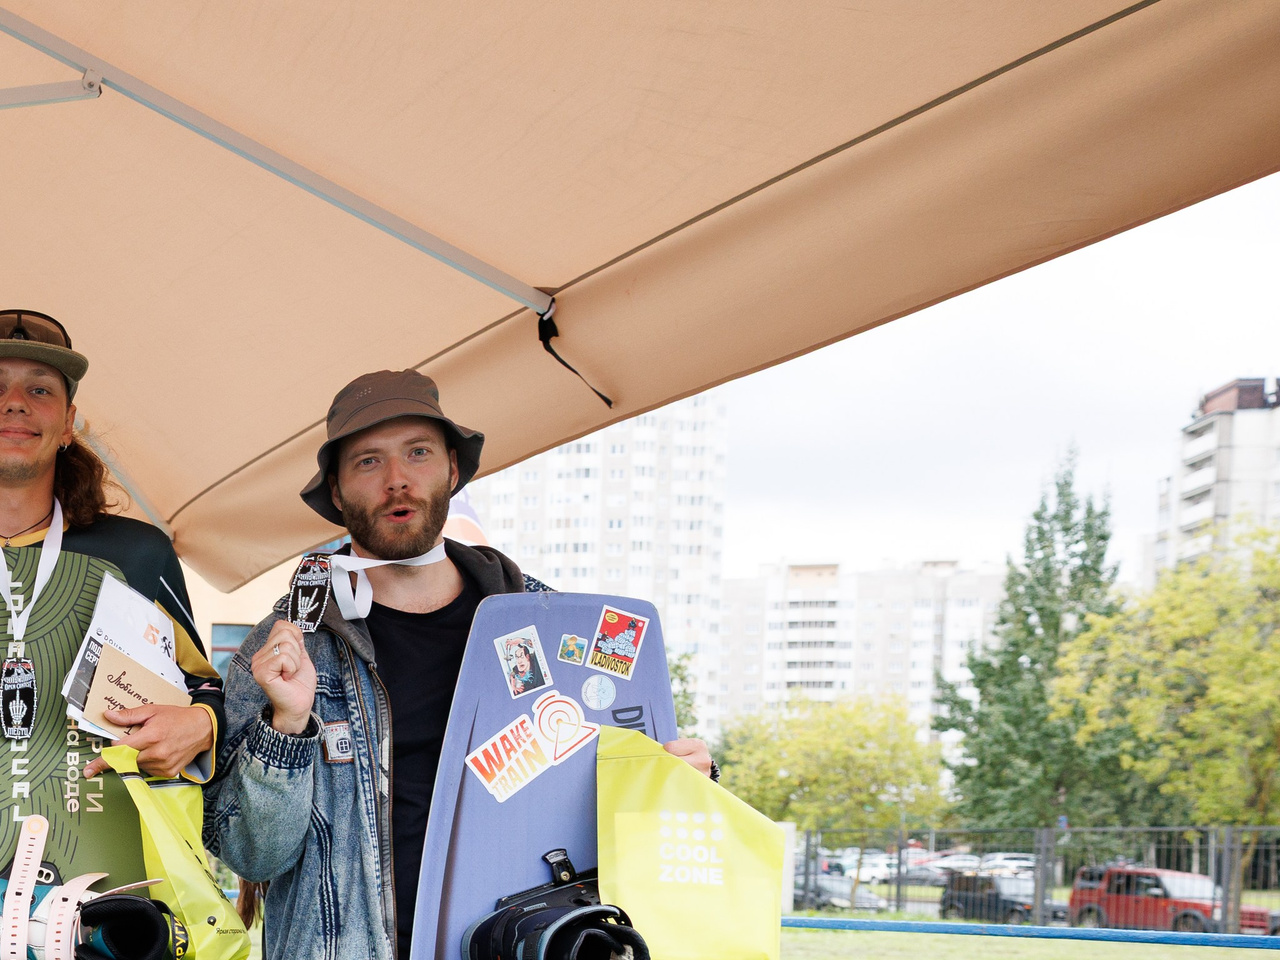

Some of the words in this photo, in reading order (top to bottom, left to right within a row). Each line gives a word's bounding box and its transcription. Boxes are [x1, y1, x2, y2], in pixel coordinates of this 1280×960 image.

[590, 652, 631, 676] VLADIVOSTOK
[471, 719, 533, 784] WAKE
[492, 737, 549, 800] TRAIN
[658, 844, 724, 865] COOL
[658, 864, 724, 886] ZONE
